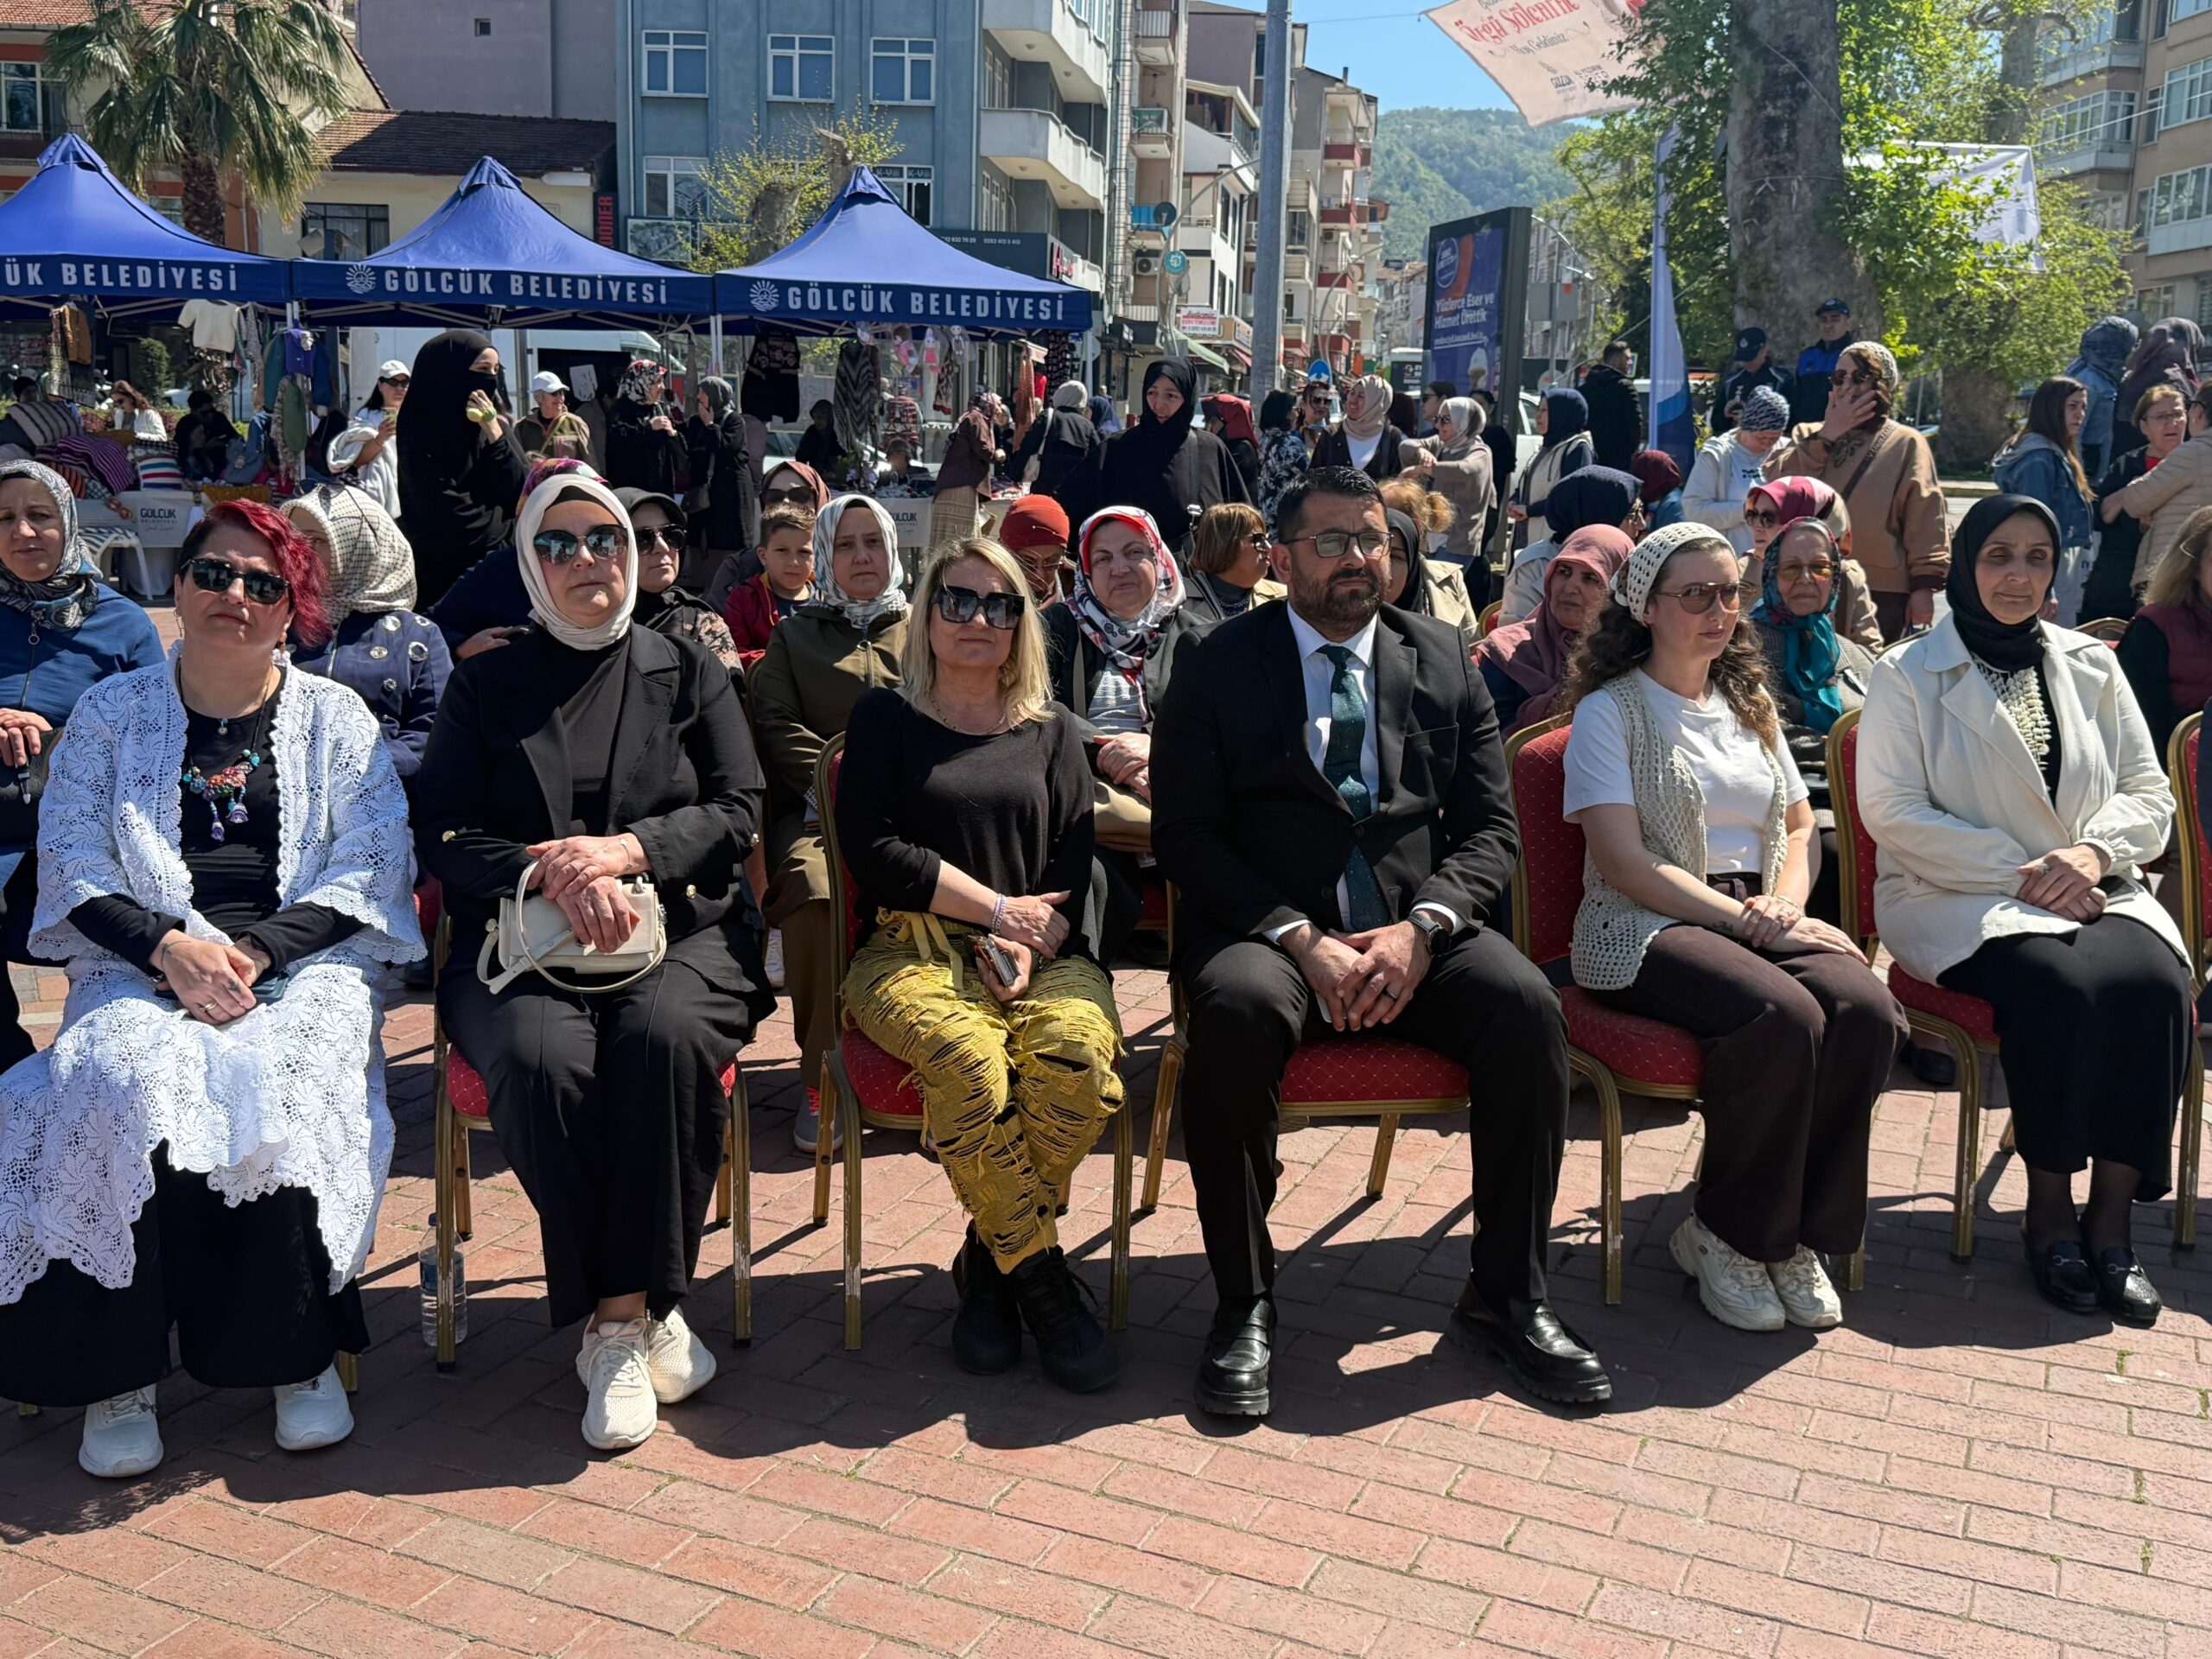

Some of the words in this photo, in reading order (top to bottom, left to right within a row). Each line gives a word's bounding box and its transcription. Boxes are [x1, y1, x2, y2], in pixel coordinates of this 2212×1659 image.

[61, 261, 237, 291] BELEDİYESİ
[385, 267, 493, 296] GÖLCÜK
[511, 274, 667, 305] BELEDİYESİ
[787, 282, 894, 314] GÖLCÜK
[911, 290, 1064, 321] BELEDİYESİ
[1436, 297, 1465, 312] Yüzlerce
[1466, 294, 1483, 307] Eser
[1484, 293, 1494, 304] ve
[1434, 315, 1459, 329] Hizmet
[1461, 308, 1486, 325] Ürettik
